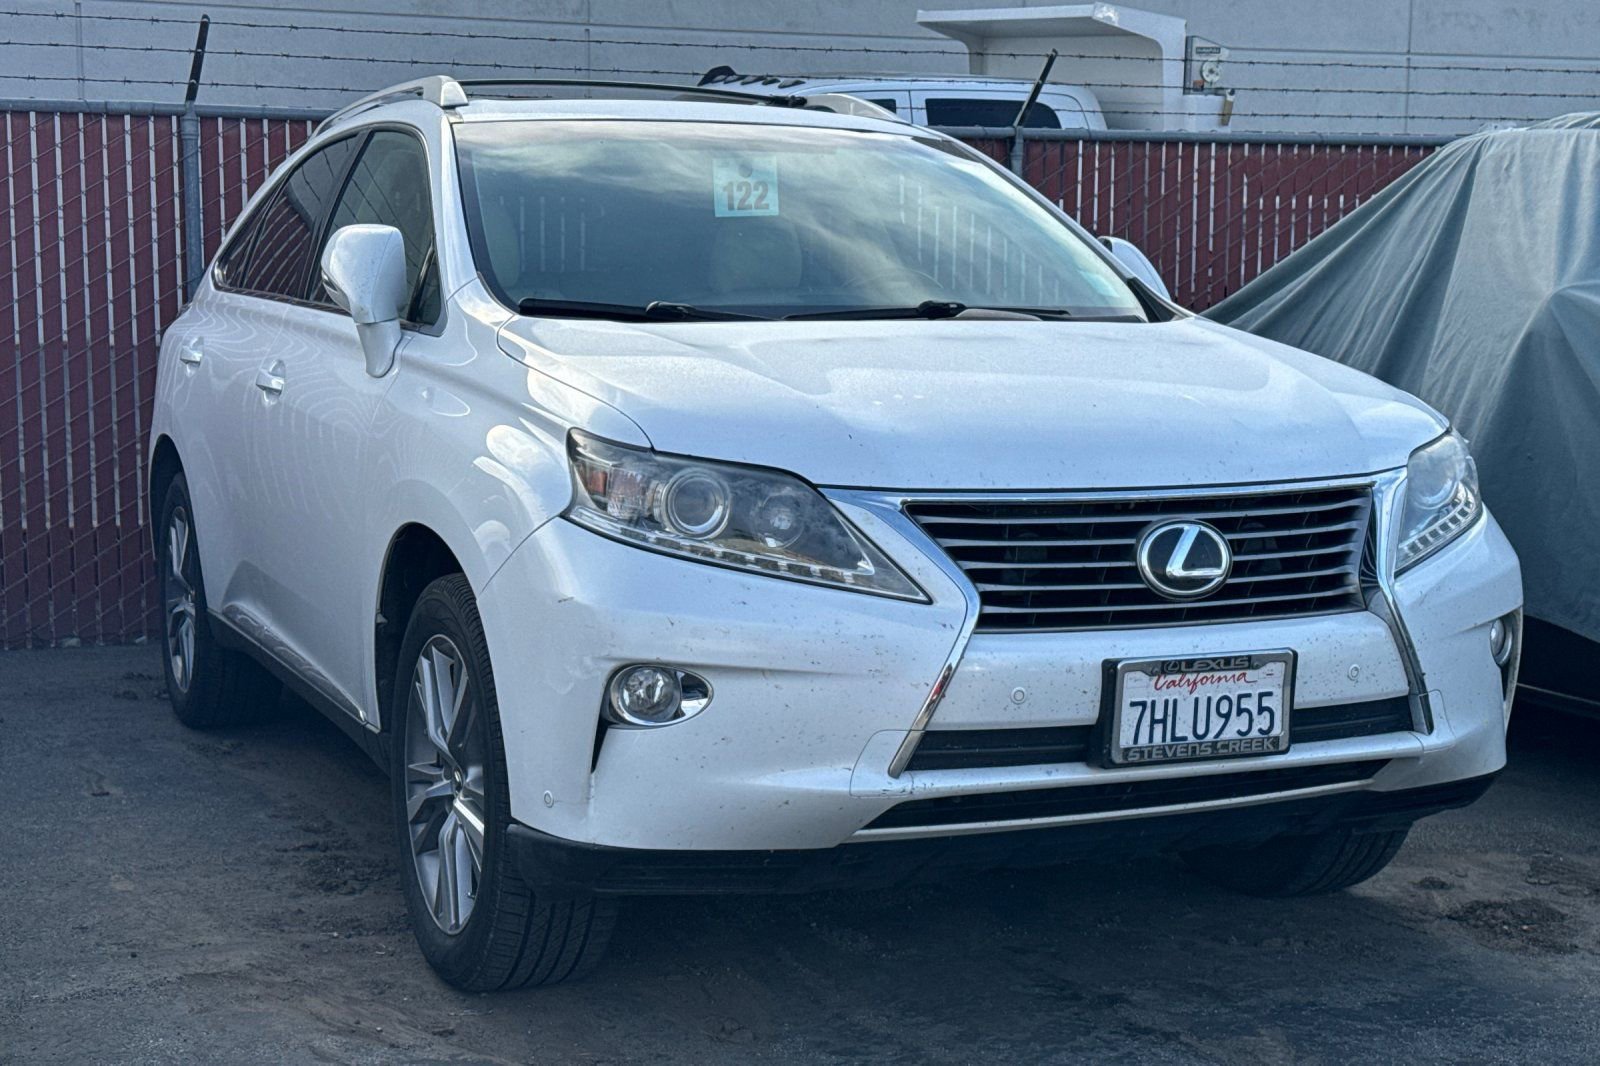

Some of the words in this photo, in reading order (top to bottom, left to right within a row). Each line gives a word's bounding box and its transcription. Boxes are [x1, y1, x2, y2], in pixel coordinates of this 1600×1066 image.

[724, 181, 769, 211] 122
[1181, 657, 1250, 672] LEXUS
[1154, 672, 1257, 695] California
[1130, 691, 1275, 745] 7HLU955
[1128, 743, 1212, 761] STEVENS
[1217, 738, 1274, 755] CREEK
